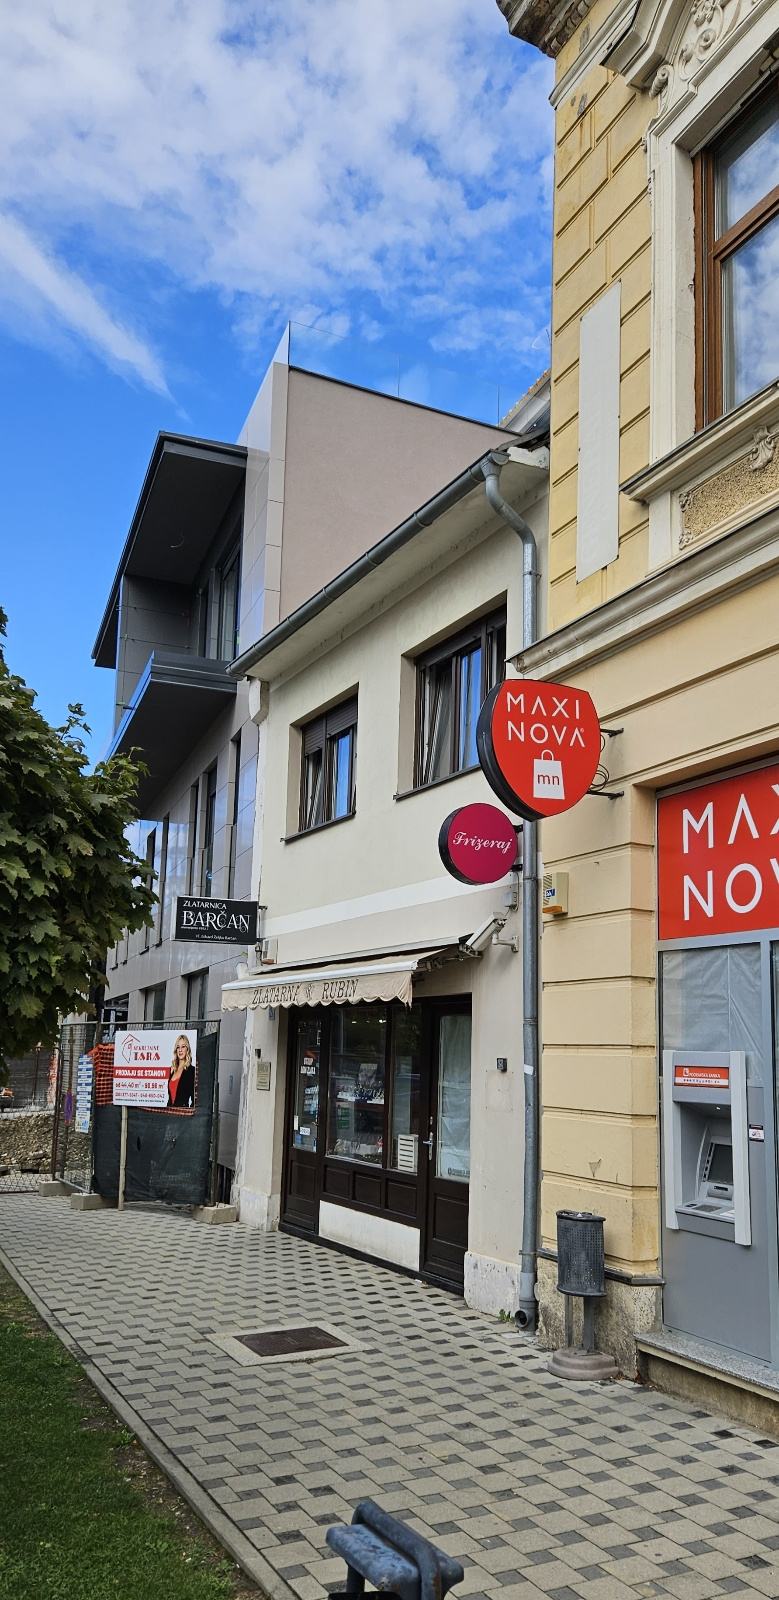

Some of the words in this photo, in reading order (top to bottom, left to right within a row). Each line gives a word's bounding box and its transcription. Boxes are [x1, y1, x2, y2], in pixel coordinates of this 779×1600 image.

[506, 691, 580, 720] MAXI
[507, 720, 586, 748] NOVA
[537, 774, 560, 786] mn
[452, 831, 513, 854] Frizeraj
[183, 900, 227, 910] ZLATARNICA
[181, 910, 252, 934] BARČAN
[321, 979, 359, 1000] RUBIN
